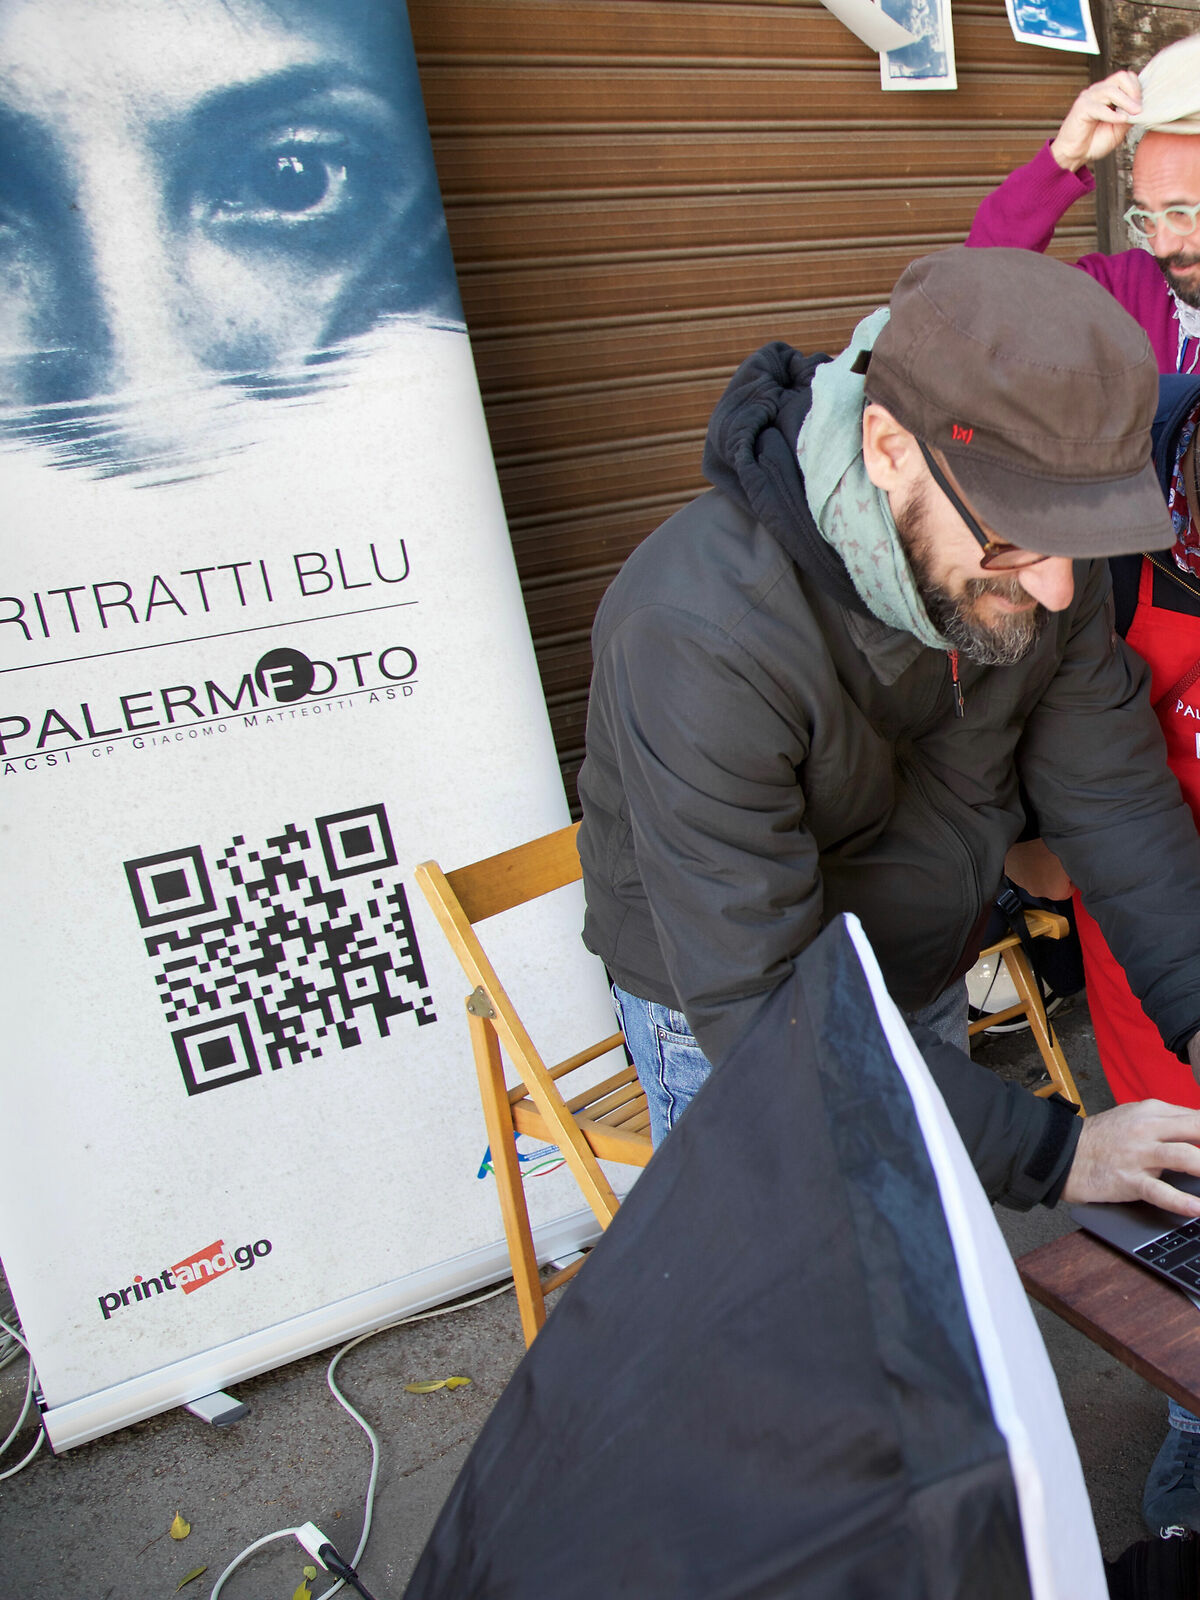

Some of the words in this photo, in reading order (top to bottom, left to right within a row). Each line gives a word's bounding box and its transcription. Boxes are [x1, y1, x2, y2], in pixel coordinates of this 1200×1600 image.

[0, 559, 273, 641] RITRATTI
[293, 538, 410, 597] BLU
[4, 751, 71, 775] ACSI
[369, 685, 414, 704] ASD
